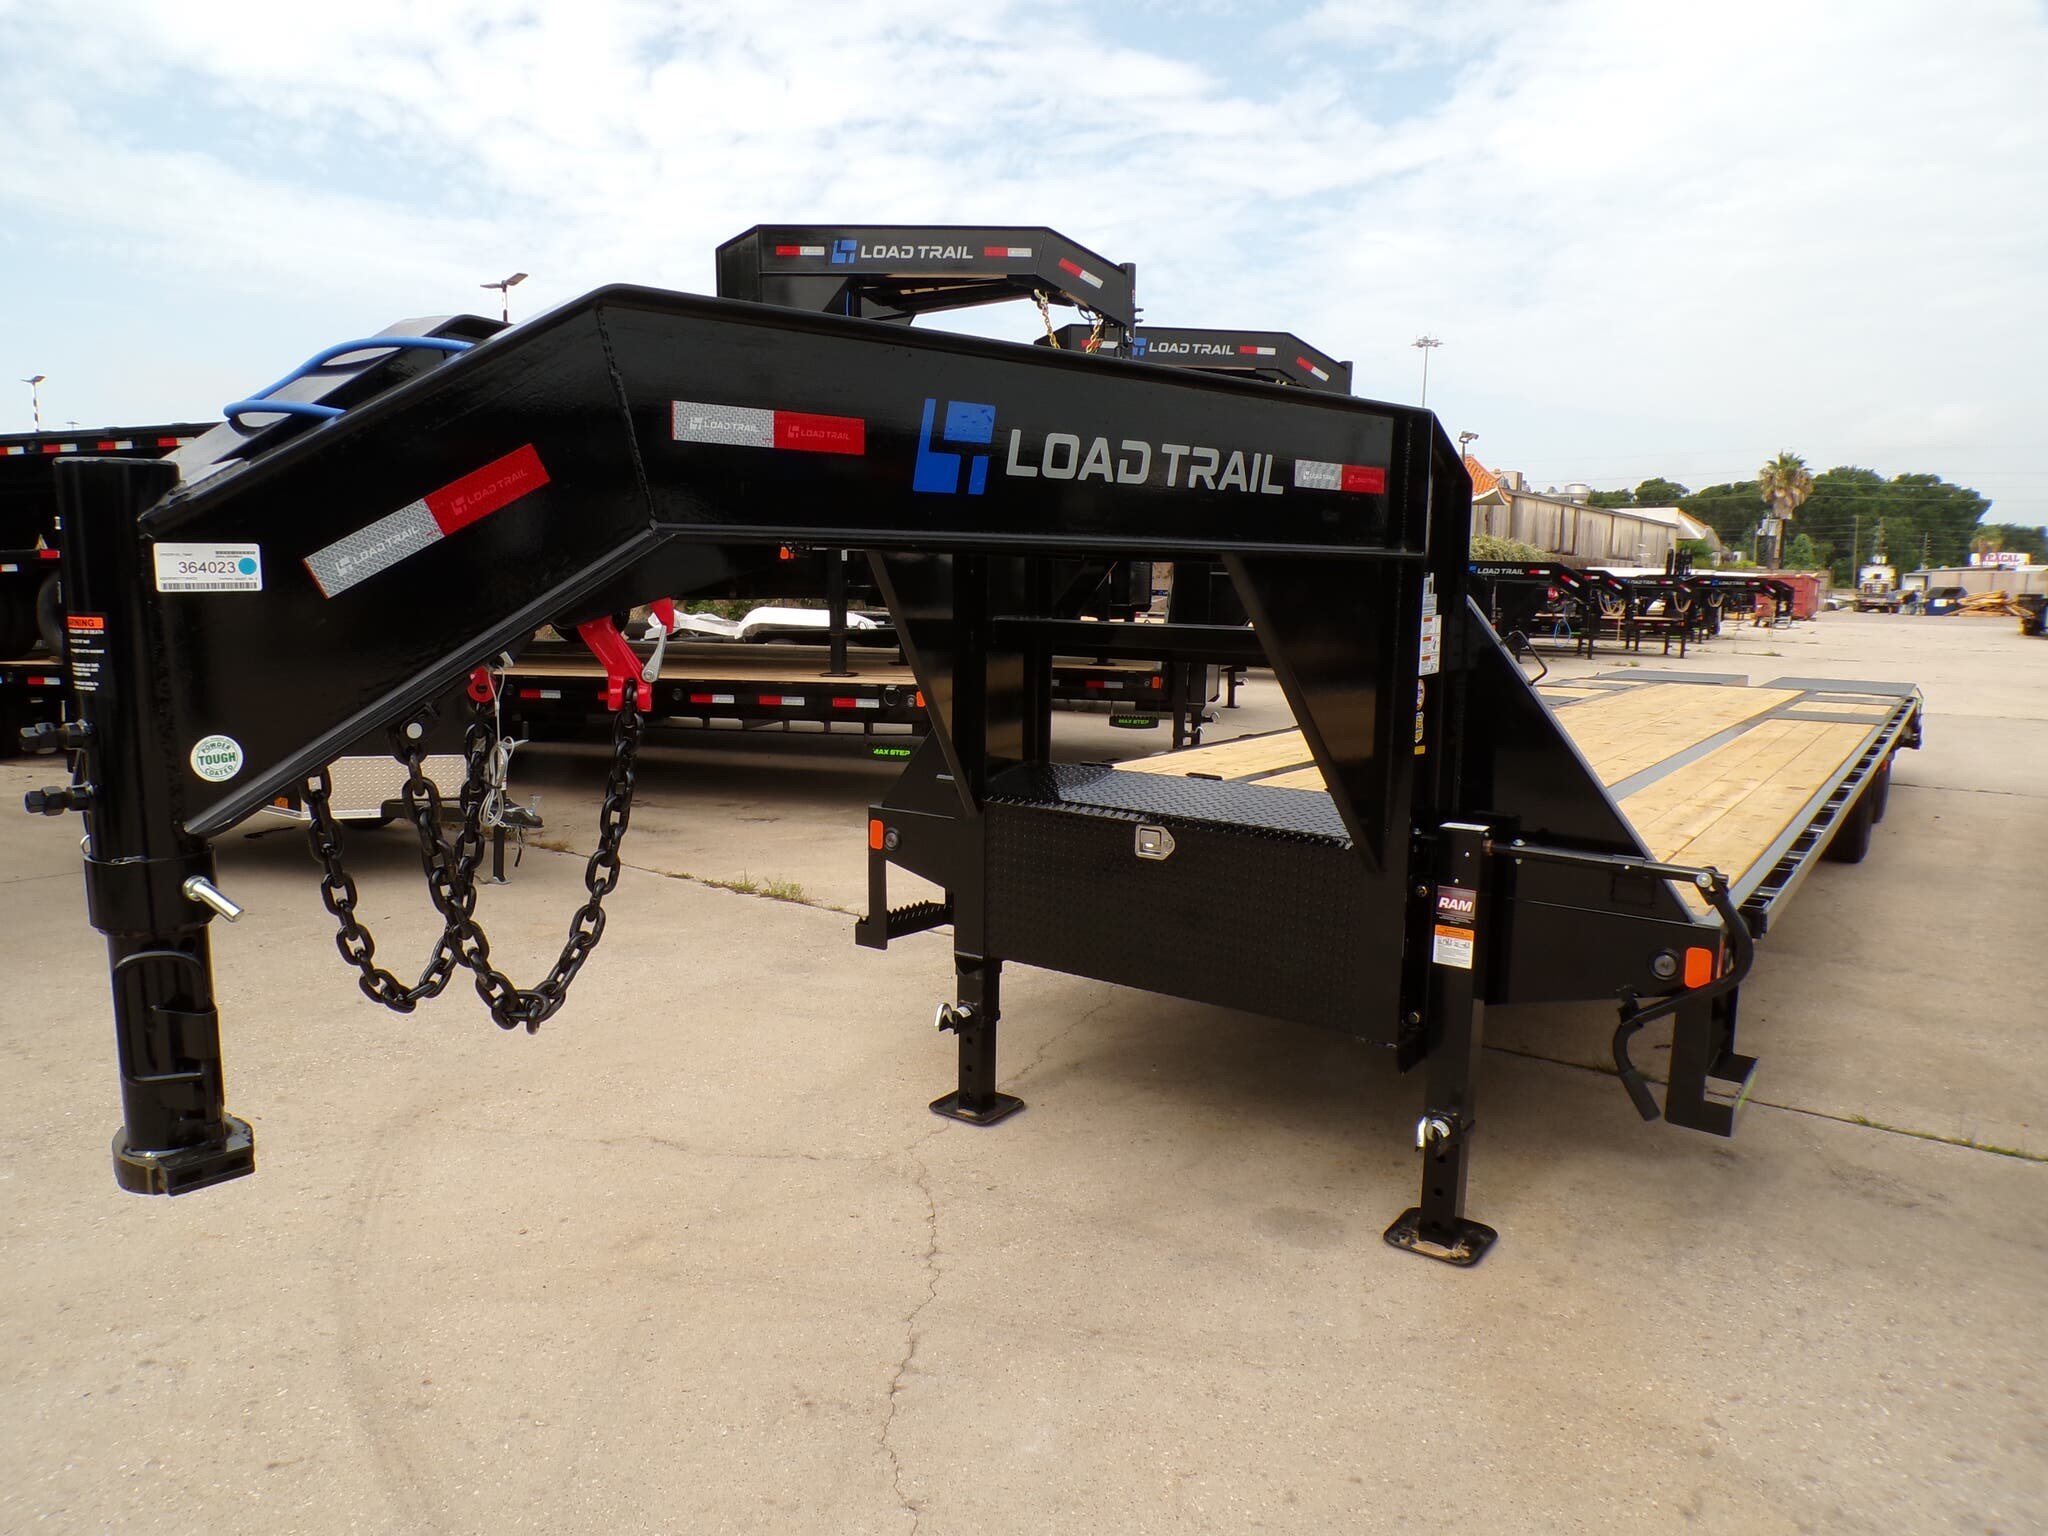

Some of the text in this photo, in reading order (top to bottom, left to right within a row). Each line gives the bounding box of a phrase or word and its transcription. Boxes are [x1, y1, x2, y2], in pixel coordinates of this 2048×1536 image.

[860, 245, 973, 259] LOAD TRAIL
[1149, 342, 1235, 355] LOAD TRAIL
[703, 421, 760, 433] LOAD TRAIL
[801, 429, 850, 441] LOAD TRAIL
[1006, 429, 1284, 495] LOAD TRAIL
[467, 468, 529, 505] LOAD TRAIL
[353, 526, 420, 565] LOAD TRAIL
[178, 561, 236, 574] 364023
[1477, 567, 1500, 575] LOAD
[198, 752, 236, 766] TOUGH
[205, 765, 234, 776] COATED
[1438, 897, 1473, 912] RAM
